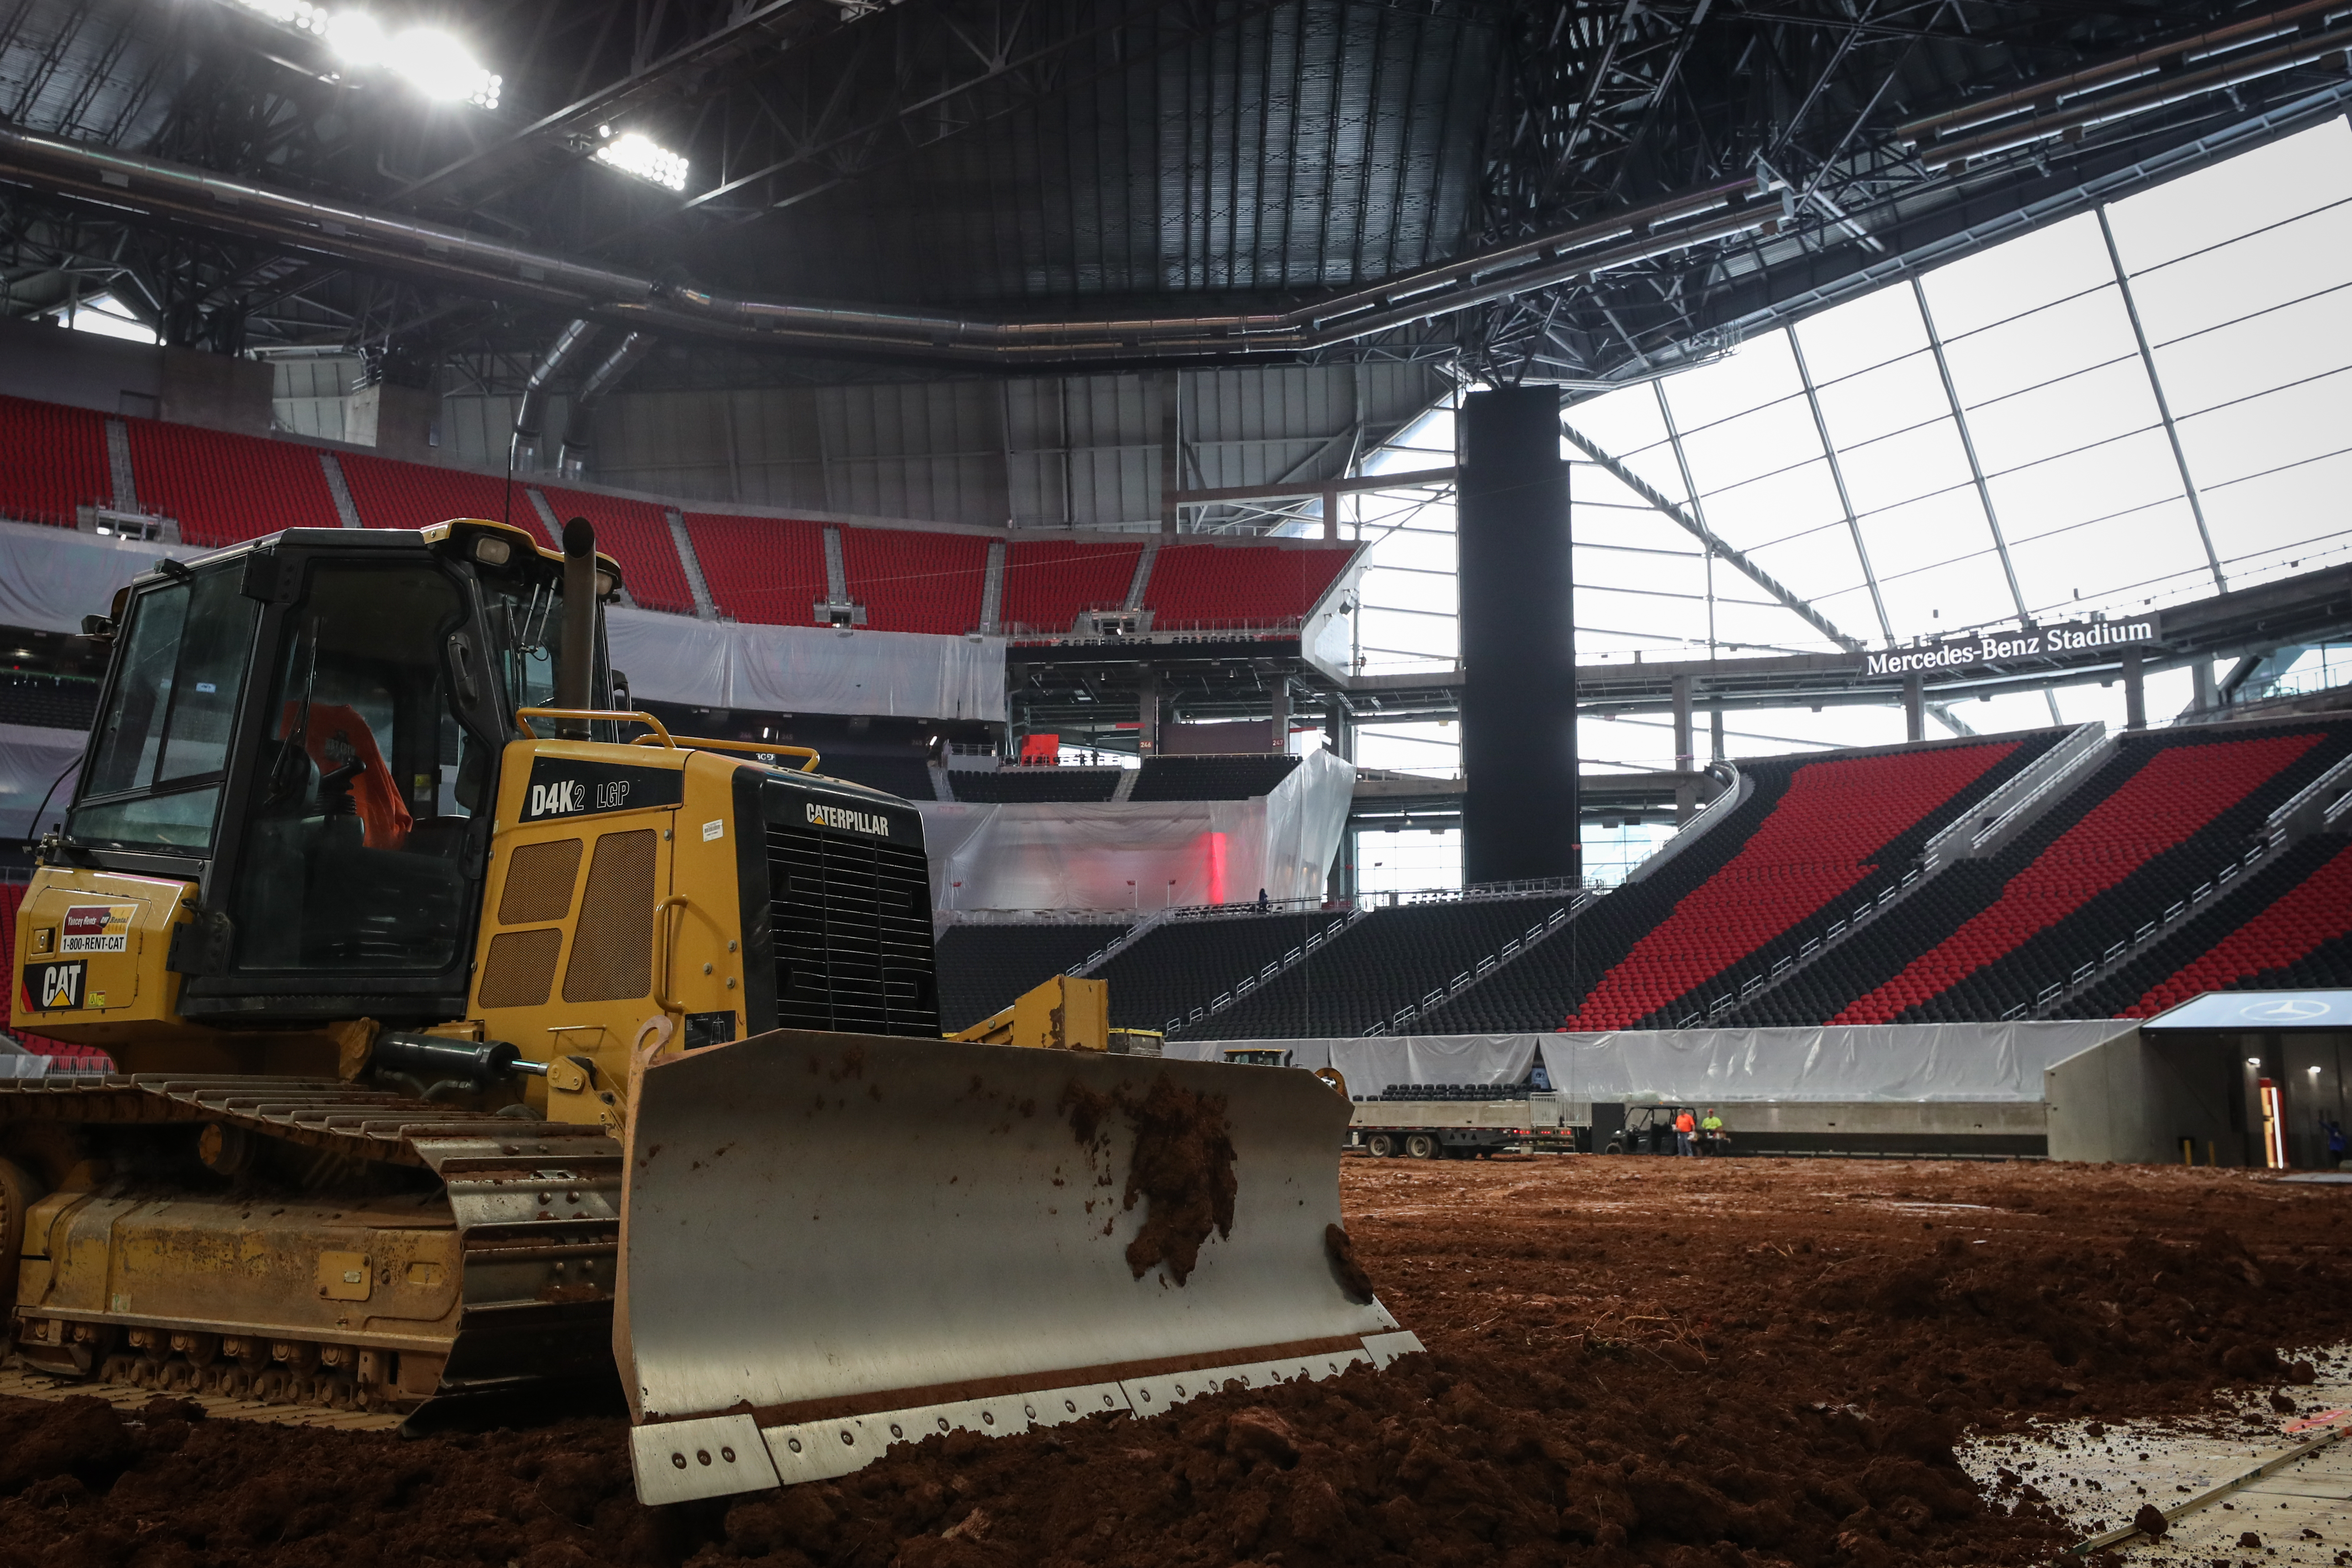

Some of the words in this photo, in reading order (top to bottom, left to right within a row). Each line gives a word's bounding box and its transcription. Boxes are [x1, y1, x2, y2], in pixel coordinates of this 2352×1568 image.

[1867, 636, 2040, 675] Mercedes-Benz
[2047, 621, 2152, 652] Stadium
[531, 780, 584, 817] D4K2
[596, 780, 630, 808] LGP
[805, 802, 889, 837] CATERPILLAR
[68, 916, 83, 927] Yancey
[83, 916, 96, 925] Rents
[63, 937, 124, 950] 1-800-RENT-CAT
[42, 964, 81, 1007] CAT
